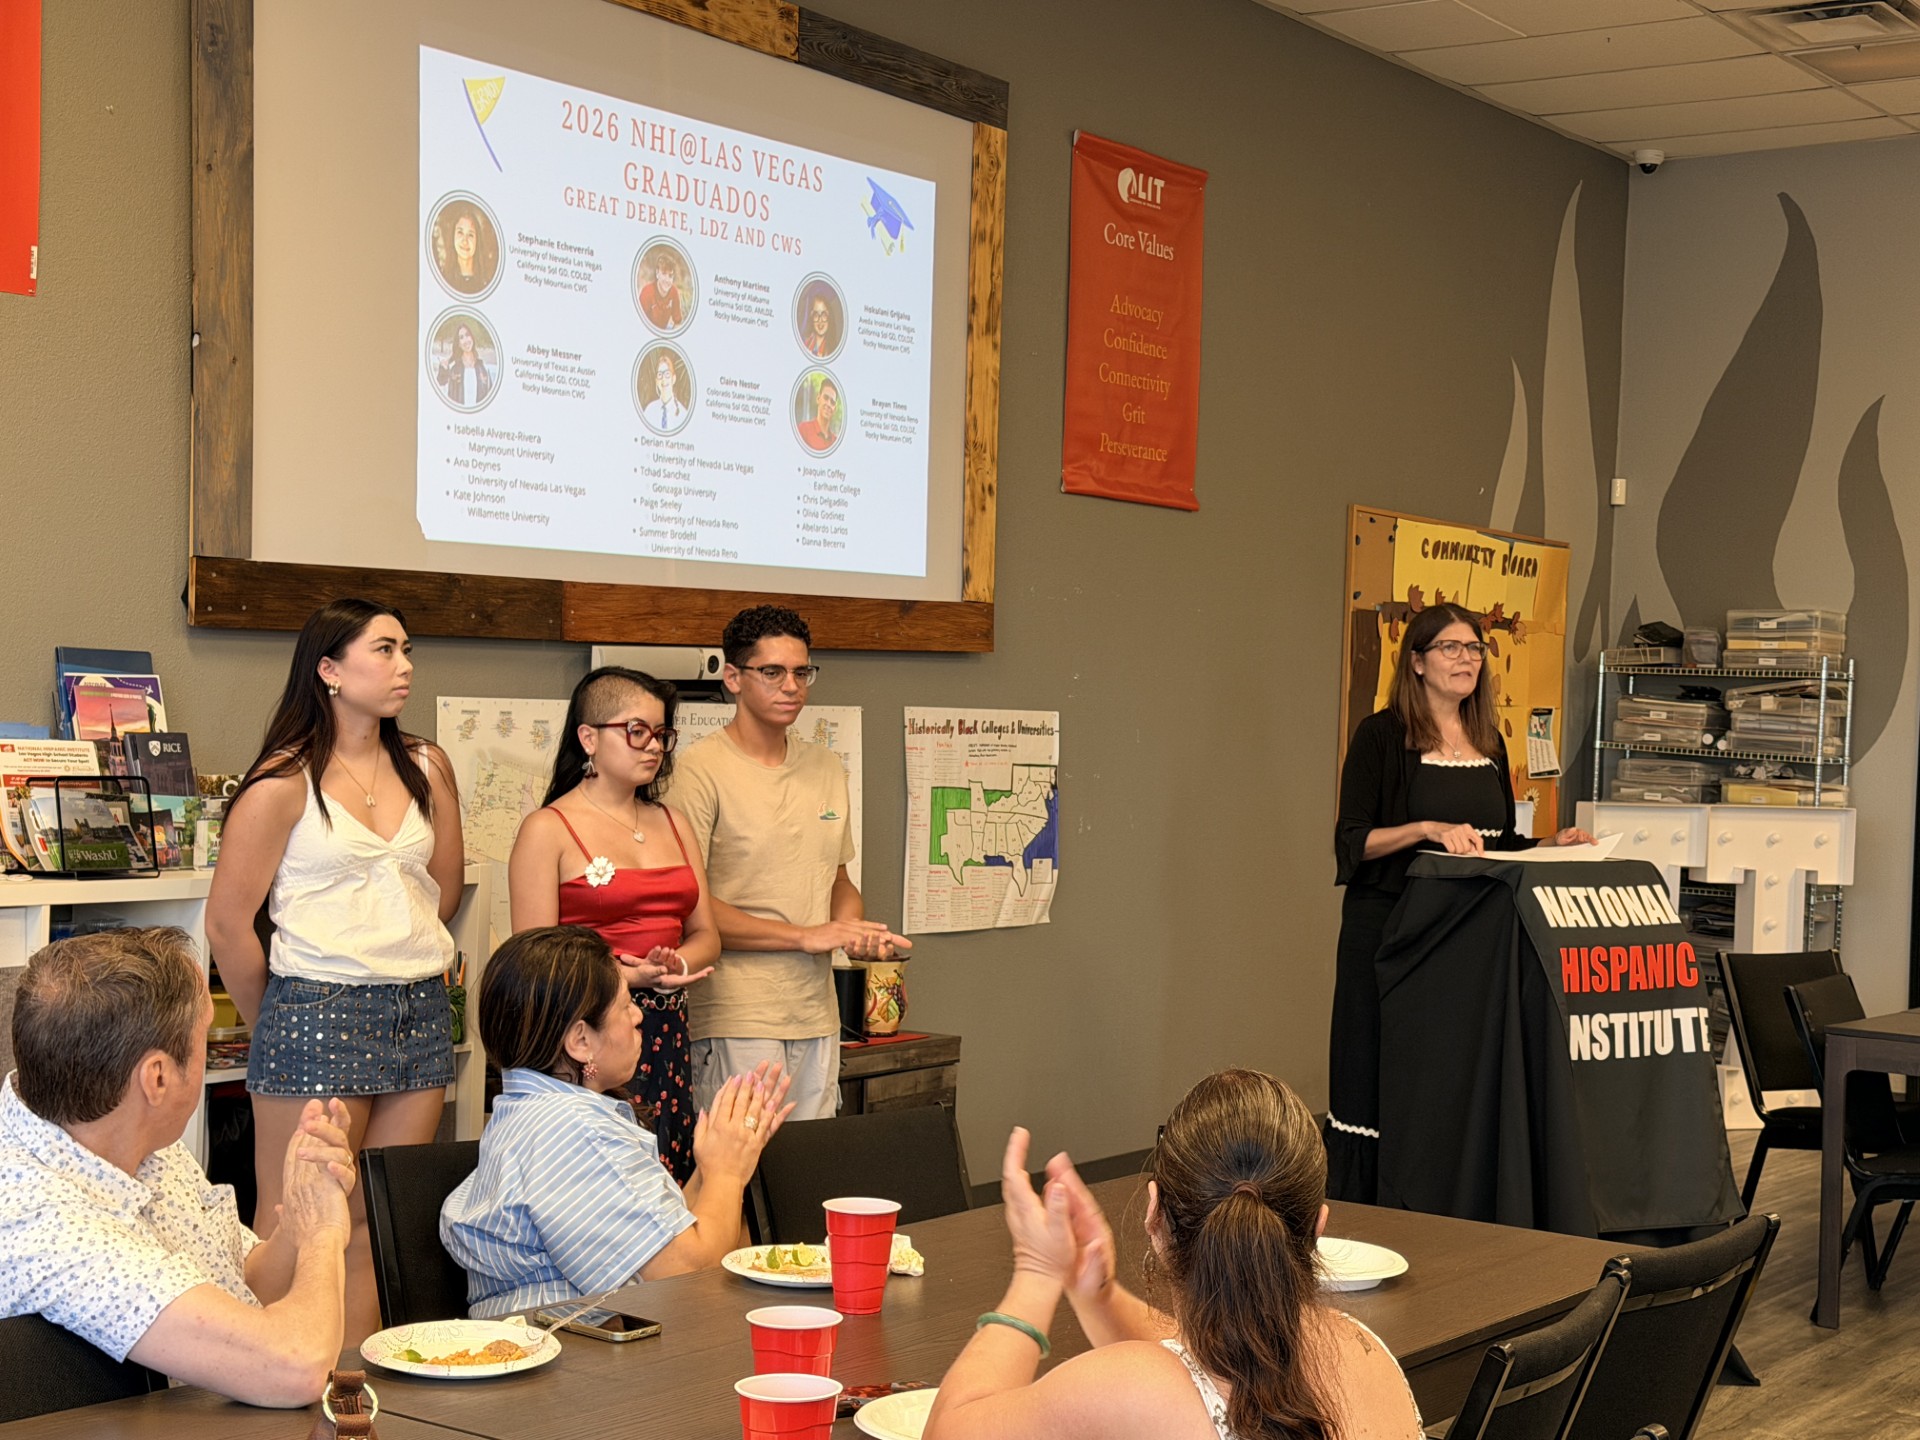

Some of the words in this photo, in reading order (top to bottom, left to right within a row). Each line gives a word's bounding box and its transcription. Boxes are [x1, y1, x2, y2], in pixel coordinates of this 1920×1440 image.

[561, 100, 619, 141] 2026
[630, 117, 743, 173] NHI@LAS
[752, 150, 824, 193] VEGAS
[623, 162, 771, 222] GRADUADOS
[563, 186, 620, 218] GREAT
[626, 200, 693, 236] DEBATE,
[699, 214, 729, 238] LDZ
[734, 222, 765, 247] AND
[771, 233, 802, 256] CWS
[1104, 222, 1136, 250] Core
[1137, 230, 1175, 261] Values
[509, 244, 540, 261] University
[714, 286, 740, 301] University
[1110, 293, 1164, 330] Advocacy
[1103, 327, 1168, 361] Confidence
[511, 355, 542, 370] University
[1098, 362, 1172, 400] Connectivity
[745, 392, 771, 406] University
[1122, 402, 1146, 425] Grit
[454, 424, 484, 437] Isabella
[486, 427, 541, 443] Alvarez-Rivera
[640, 436, 664, 448] Derian
[665, 439, 694, 450] Kartman
[468, 441, 514, 456] Marymount
[516, 446, 554, 463] University
[1099, 432, 1168, 463] Perseverance
[454, 456, 469, 468] Ana
[471, 458, 500, 472] Deynes
[652, 453, 686, 468] University
[688, 458, 695, 467] of
[696, 458, 721, 470] Nevada
[723, 461, 733, 471] Las
[735, 463, 753, 475] Vegas
[662, 468, 690, 480] Sanchez
[453, 489, 471, 500] Kate
[473, 491, 505, 503] Johnson
[468, 474, 507, 490] University
[509, 479, 517, 488] of
[519, 479, 548, 492] Nevada
[549, 482, 562, 493] Las
[564, 484, 585, 497] Vegas
[652, 483, 682, 497] Gonzaga
[683, 486, 716, 501] University
[640, 496, 658, 509] Paige
[660, 498, 682, 512] Seeley
[467, 506, 509, 520] Willamette
[511, 510, 549, 526] University
[651, 513, 686, 527] University
[686, 516, 694, 525] of
[695, 516, 720, 527] Nevada
[722, 519, 738, 529] Reno
[639, 527, 668, 538] Summer
[651, 543, 685, 556] University
[686, 546, 693, 555] of
[695, 546, 720, 557] Nevada
[721, 548, 738, 558] Reno
[1421, 537, 1496, 569] COMMUNITY
[1501, 553, 1539, 578] BOARD
[908, 718, 955, 739] Historically
[958, 718, 978, 736] Black
[981, 720, 1010, 740] Colleges
[1011, 721, 1016, 735] &
[1017, 719, 1055, 736] Universities
[162, 743, 182, 753] RICE
[81, 849, 118, 862] WashU
[1532, 884, 1682, 928] NATIONAL
[1560, 941, 1699, 994] HISPANIC
[1569, 1006, 1711, 1061] NSTITUTE
